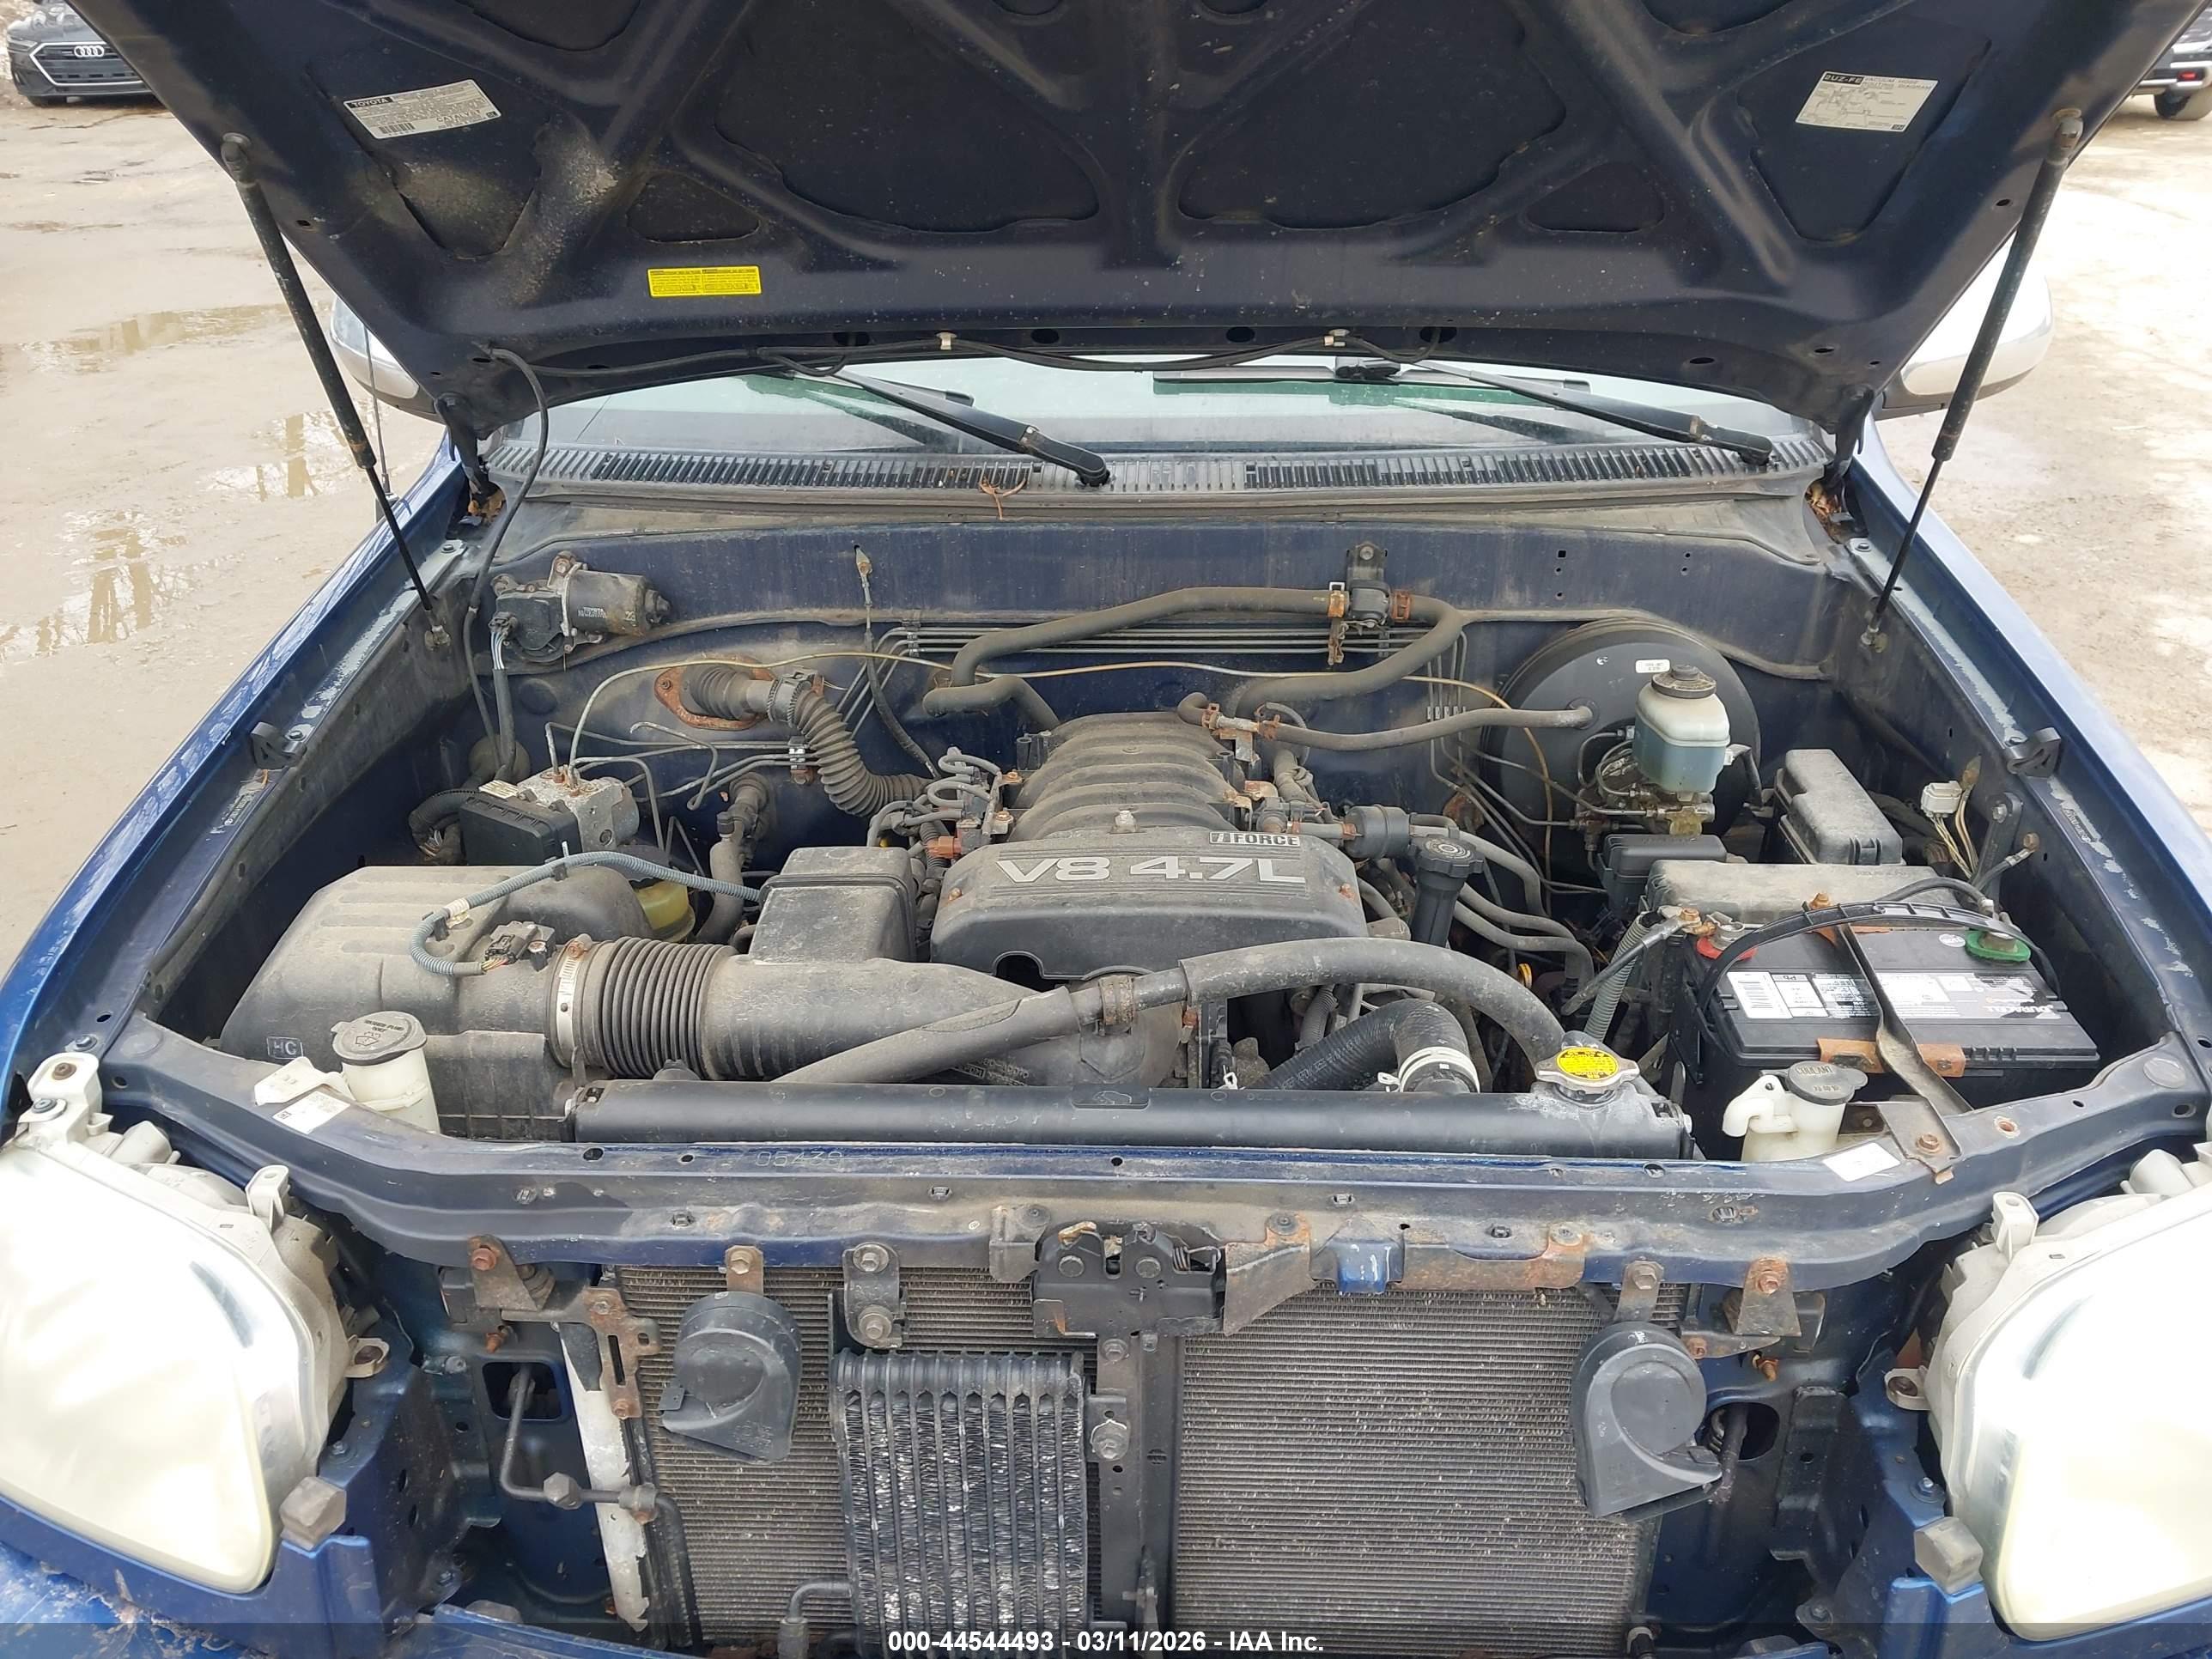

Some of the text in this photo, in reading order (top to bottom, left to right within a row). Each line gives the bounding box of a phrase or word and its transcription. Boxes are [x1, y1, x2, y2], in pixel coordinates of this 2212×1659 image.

[1824, 74, 1863, 84] 2UZ-FE
[351, 98, 388, 108] TOYOTA
[996, 856, 1306, 884] V8 4.7L
